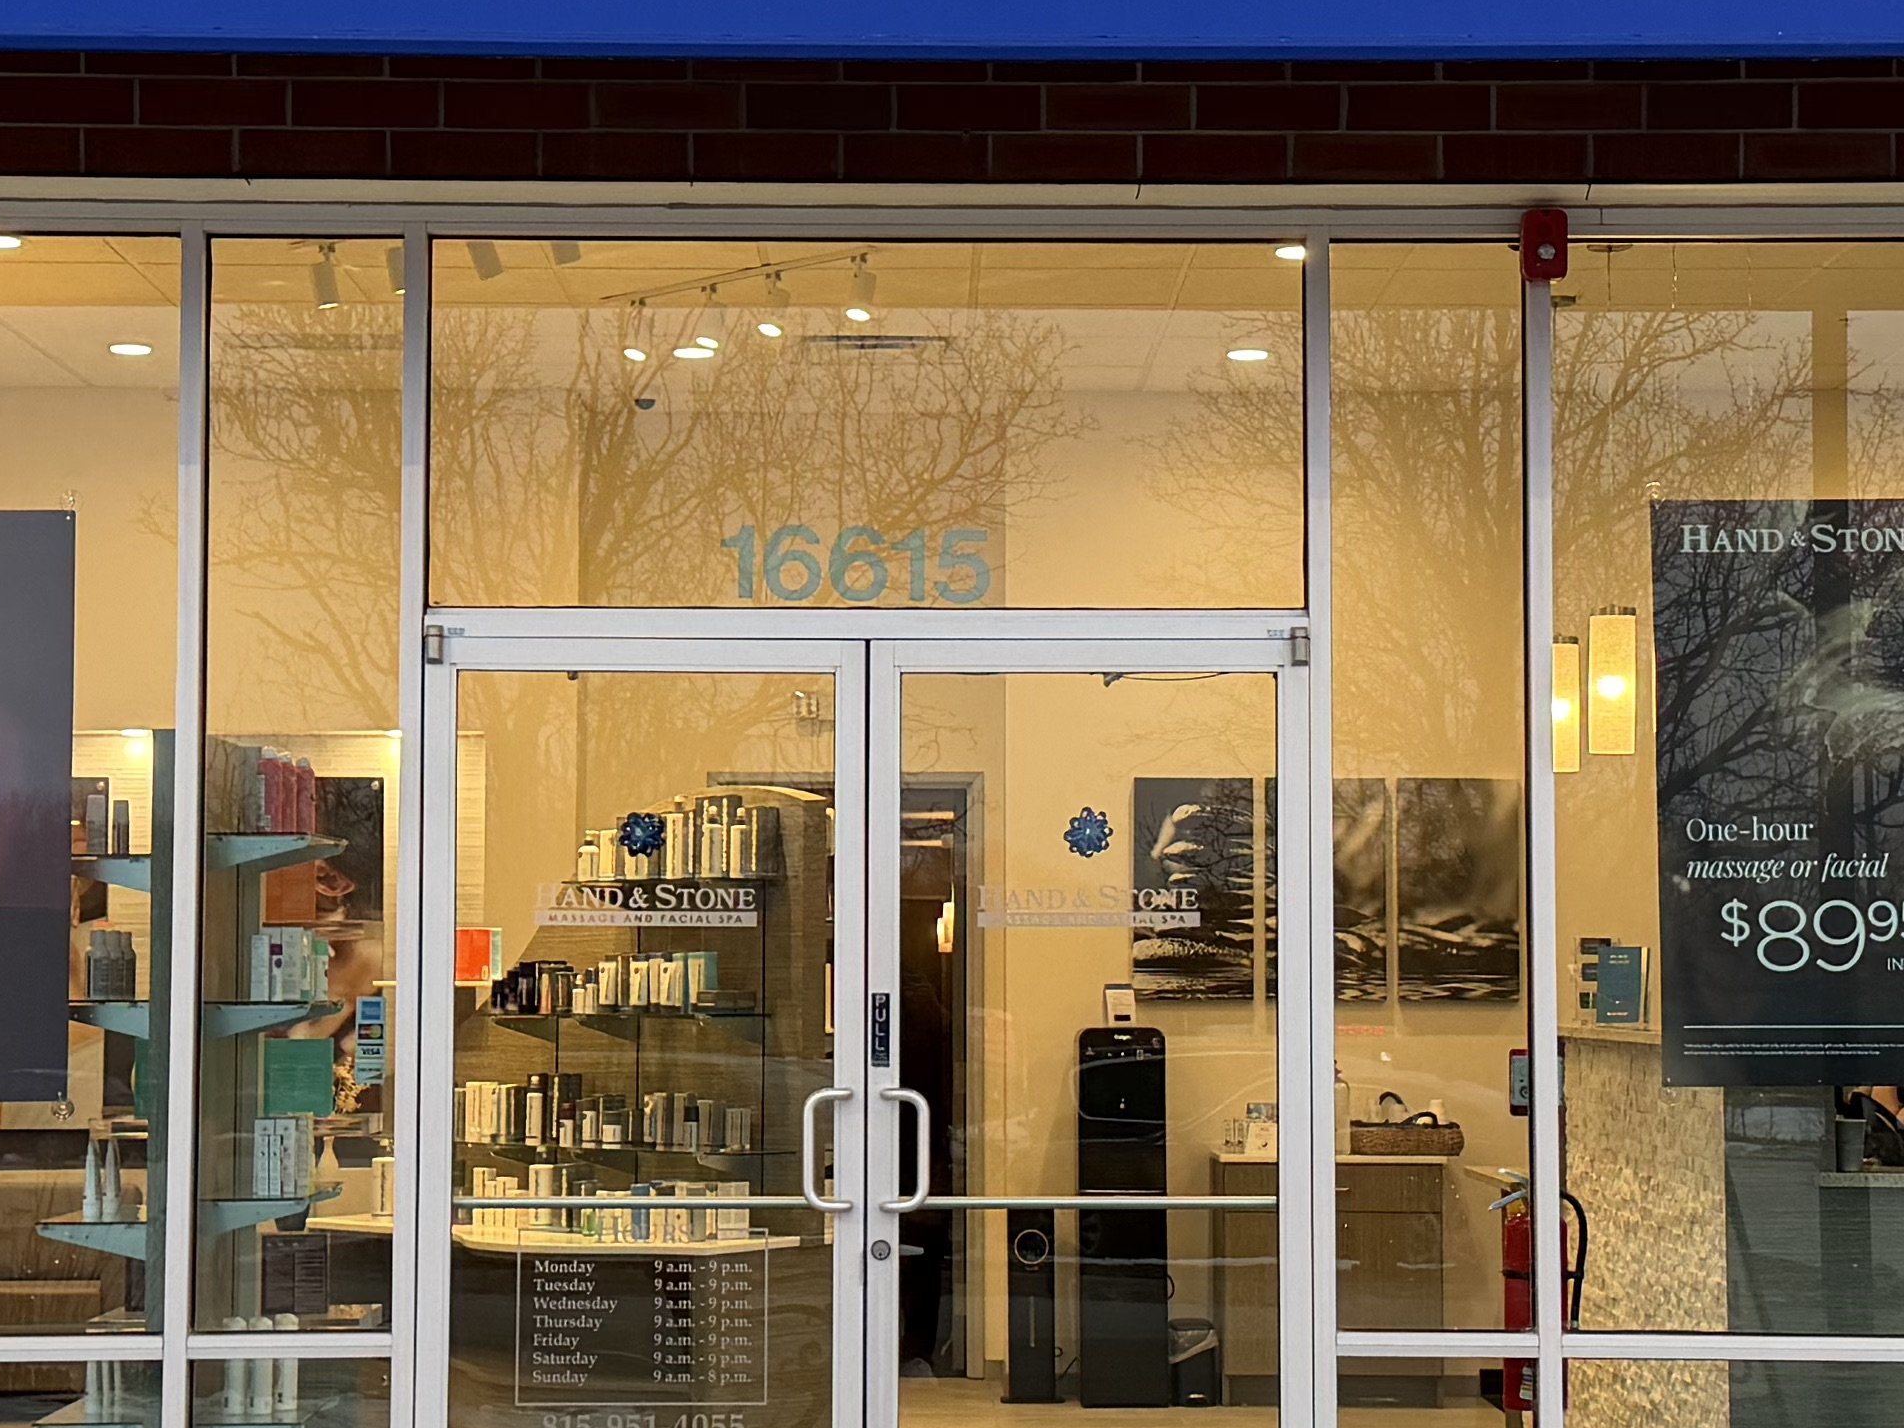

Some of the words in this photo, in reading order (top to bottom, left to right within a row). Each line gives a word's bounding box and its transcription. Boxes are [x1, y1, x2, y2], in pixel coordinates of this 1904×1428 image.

[1679, 524, 1784, 553] HAND
[1790, 531, 1807, 548] &
[720, 524, 991, 603] 16615
[1685, 816, 1814, 842] One-hour
[1686, 858, 1785, 884] massage
[1789, 858, 1818, 879] or
[1821, 853, 1890, 883] facial
[537, 884, 623, 909] HAND
[628, 886, 649, 909] &
[654, 883, 757, 910] STONE
[1098, 884, 1199, 910] STONE
[548, 913, 616, 923] MASSAGE
[624, 913, 653, 923] AND
[660, 913, 712, 924] FACIAL
[718, 913, 744, 924] SPA
[875, 994, 887, 1051] PULL
[534, 1260, 596, 1276] Monday
[654, 1261, 663, 1273] 9
[666, 1264, 696, 1273] a.m.
[708, 1261, 717, 1272] 9
[721, 1264, 753, 1276] p.m.
[533, 1278, 596, 1294] Tuesday
[654, 1279, 663, 1291] 9
[665, 1282, 696, 1291] a.m.
[708, 1279, 717, 1291] 9
[721, 1282, 753, 1294] p.m.
[533, 1297, 618, 1312] Wednesday
[654, 1297, 663, 1309] 9
[665, 1300, 696, 1309] a.m.
[708, 1297, 717, 1309] 9
[721, 1300, 753, 1313] p.m.
[533, 1315, 603, 1331] Thursday
[653, 1316, 662, 1328] 9
[665, 1319, 695, 1328] a.m.
[707, 1316, 716, 1327] 9
[720, 1319, 752, 1331] p.m.
[533, 1333, 580, 1349] Friday
[653, 1334, 662, 1346] 9
[665, 1337, 695, 1346] a.m.
[707, 1334, 716, 1346] 9
[720, 1337, 752, 1349] p.m.
[532, 1352, 598, 1368] Saturday
[653, 1353, 662, 1365] 9
[664, 1356, 695, 1365] a.m.
[707, 1353, 716, 1364] 9
[720, 1356, 752, 1368] p.m.
[532, 1371, 589, 1387] Sunday
[653, 1371, 662, 1383] 9
[664, 1374, 695, 1383] a.m.
[707, 1371, 716, 1383] 8
[720, 1374, 752, 1387] p.m.
